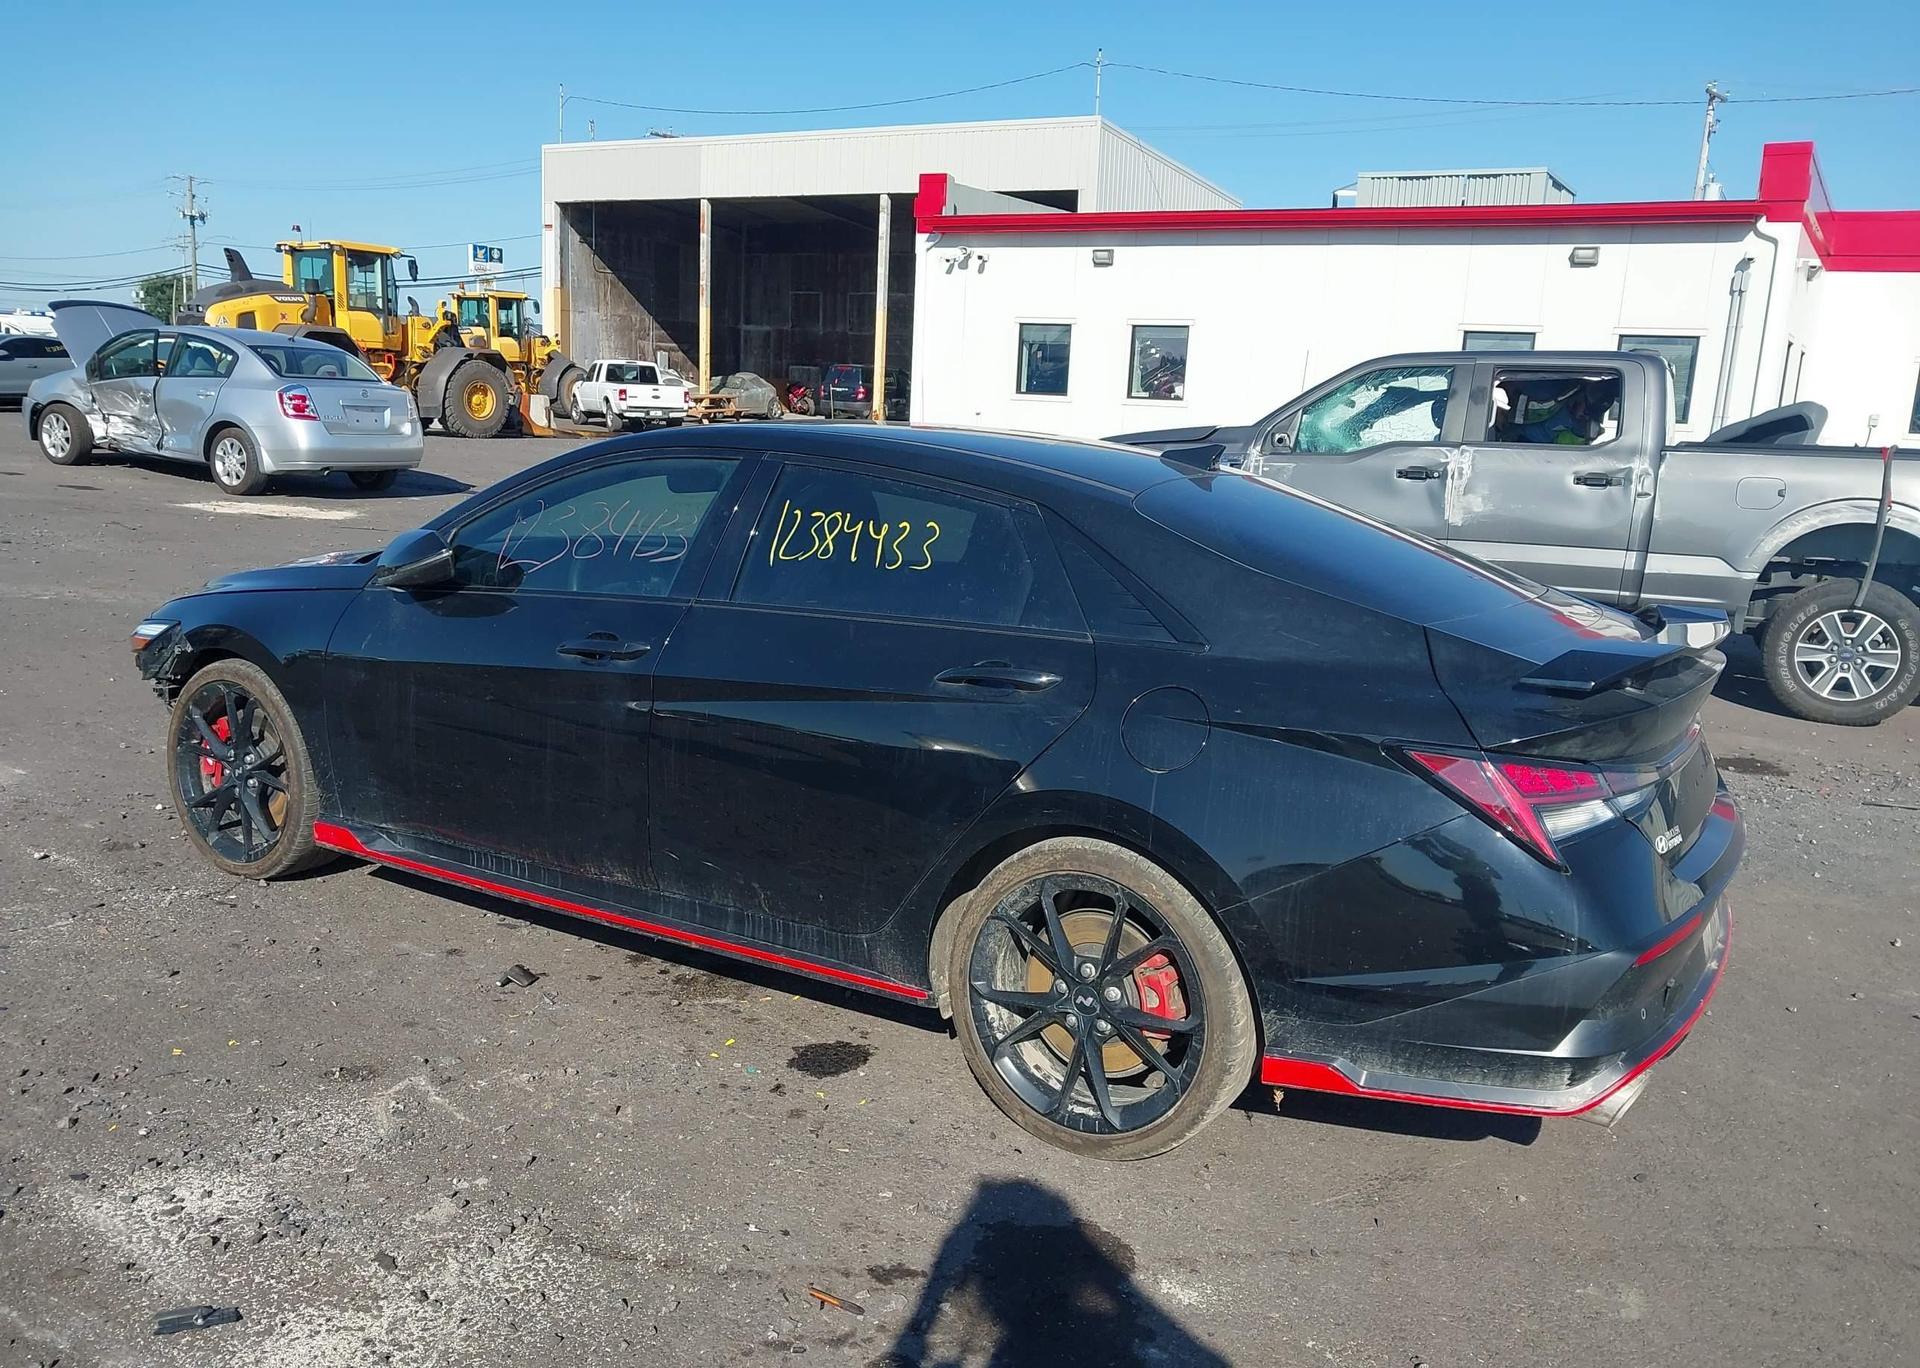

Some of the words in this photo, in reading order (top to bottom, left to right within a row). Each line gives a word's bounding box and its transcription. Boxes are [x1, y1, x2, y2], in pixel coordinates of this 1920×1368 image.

[769, 499, 940, 570] 12384433
[1776, 604, 1818, 693] WRANGLER
[1874, 618, 1919, 710] GOODYEAR
